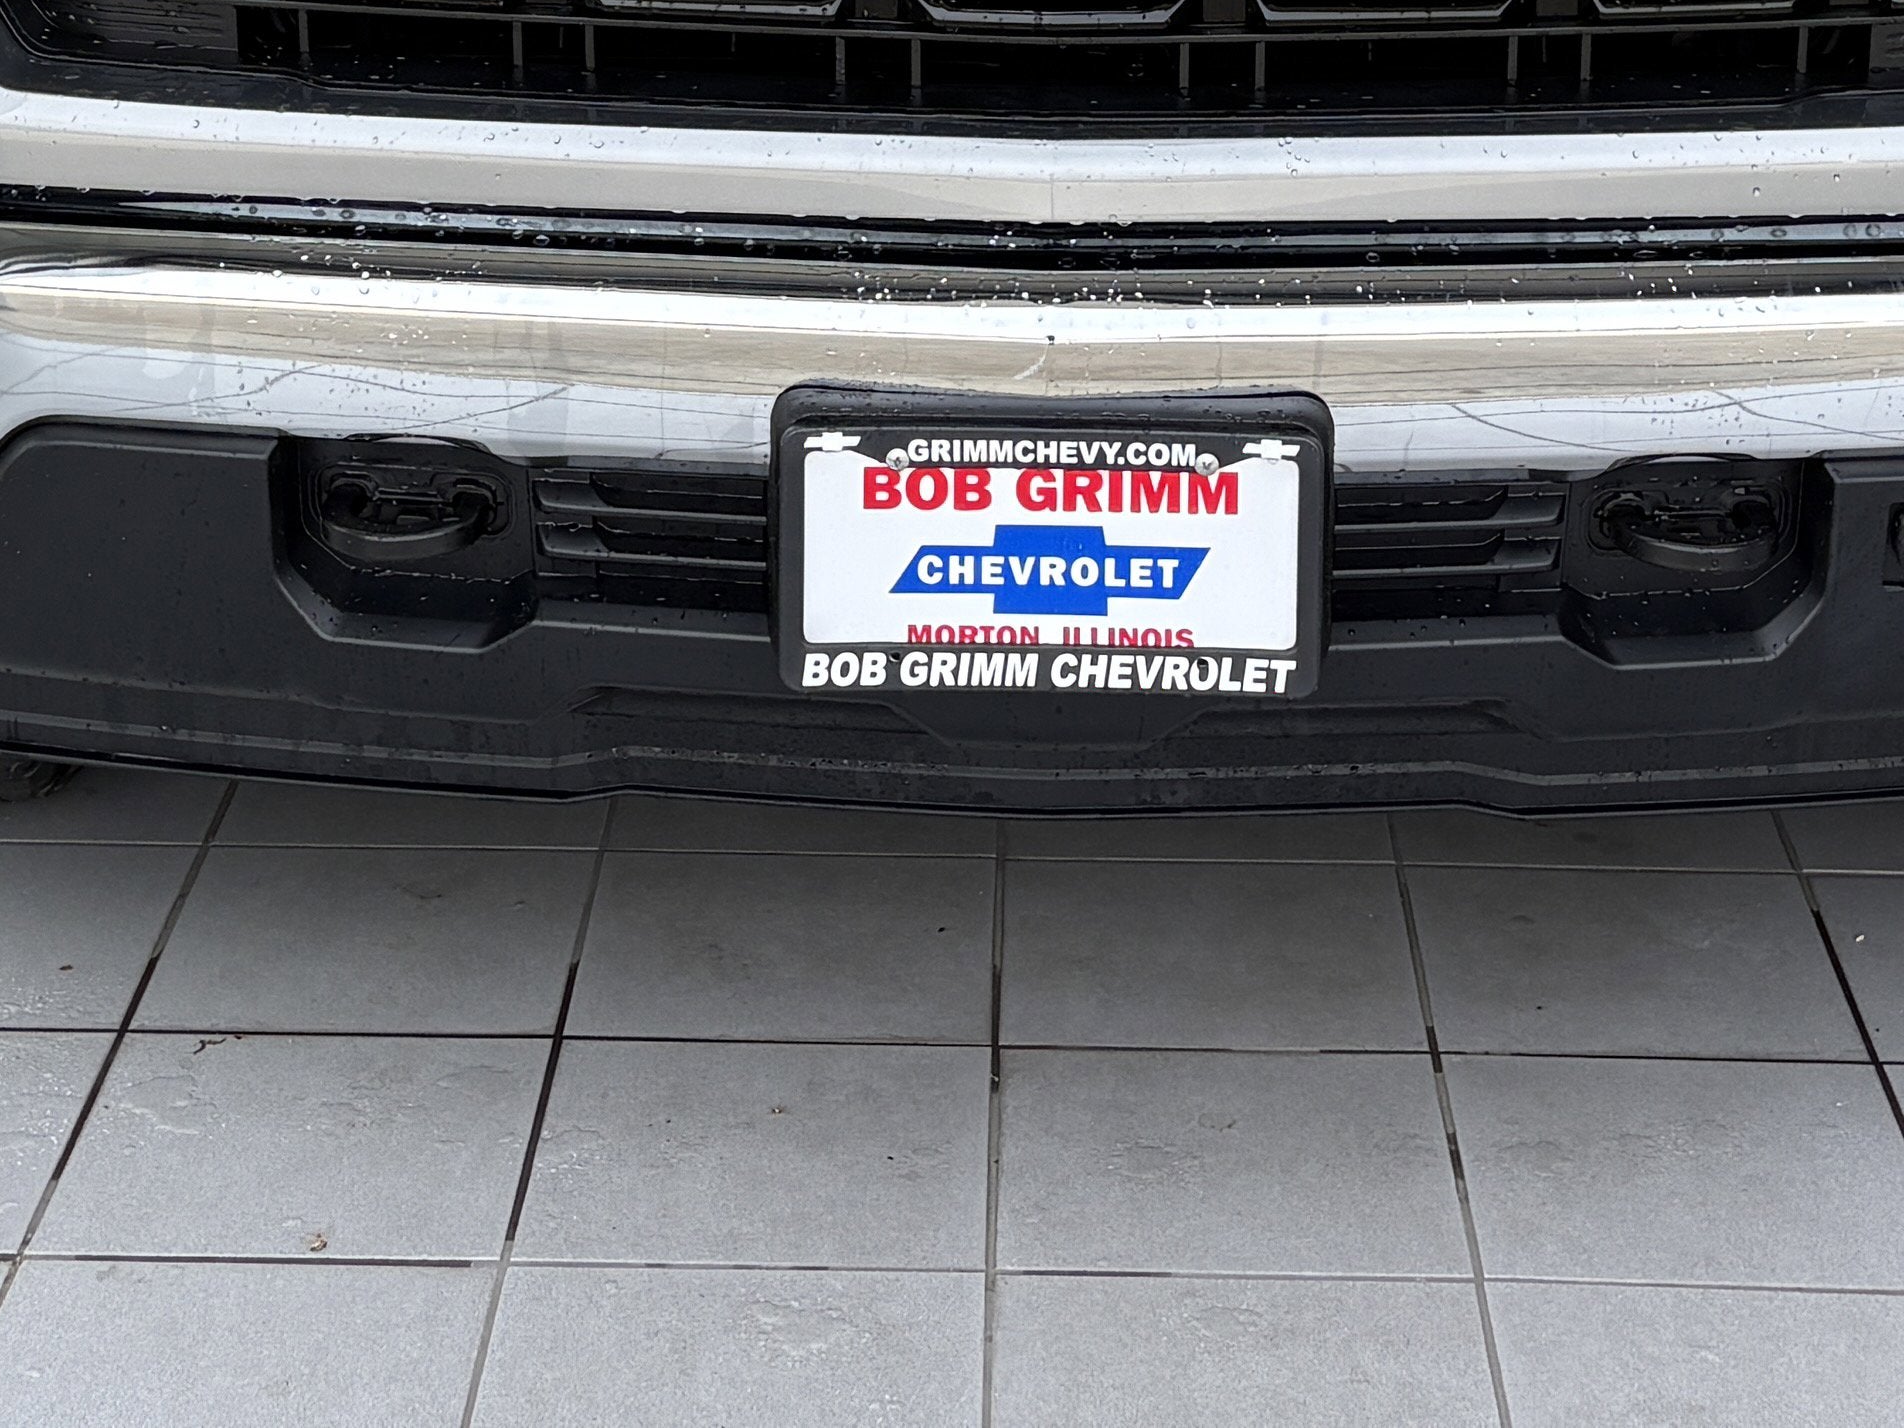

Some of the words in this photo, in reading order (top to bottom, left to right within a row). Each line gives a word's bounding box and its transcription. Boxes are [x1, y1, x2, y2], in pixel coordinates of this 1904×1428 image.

[907, 439, 1196, 466] GRIMMCHEVY.COM
[863, 466, 993, 511] BOB
[1016, 469, 1239, 515] GRIMM
[917, 554, 1179, 589] CHEVROLET
[907, 624, 1039, 646] MORTON
[1063, 626, 1194, 649] ILLINOIS
[802, 652, 888, 687] BOB
[898, 651, 1038, 688] GRIMM
[1051, 654, 1297, 694] CHEVROLET
